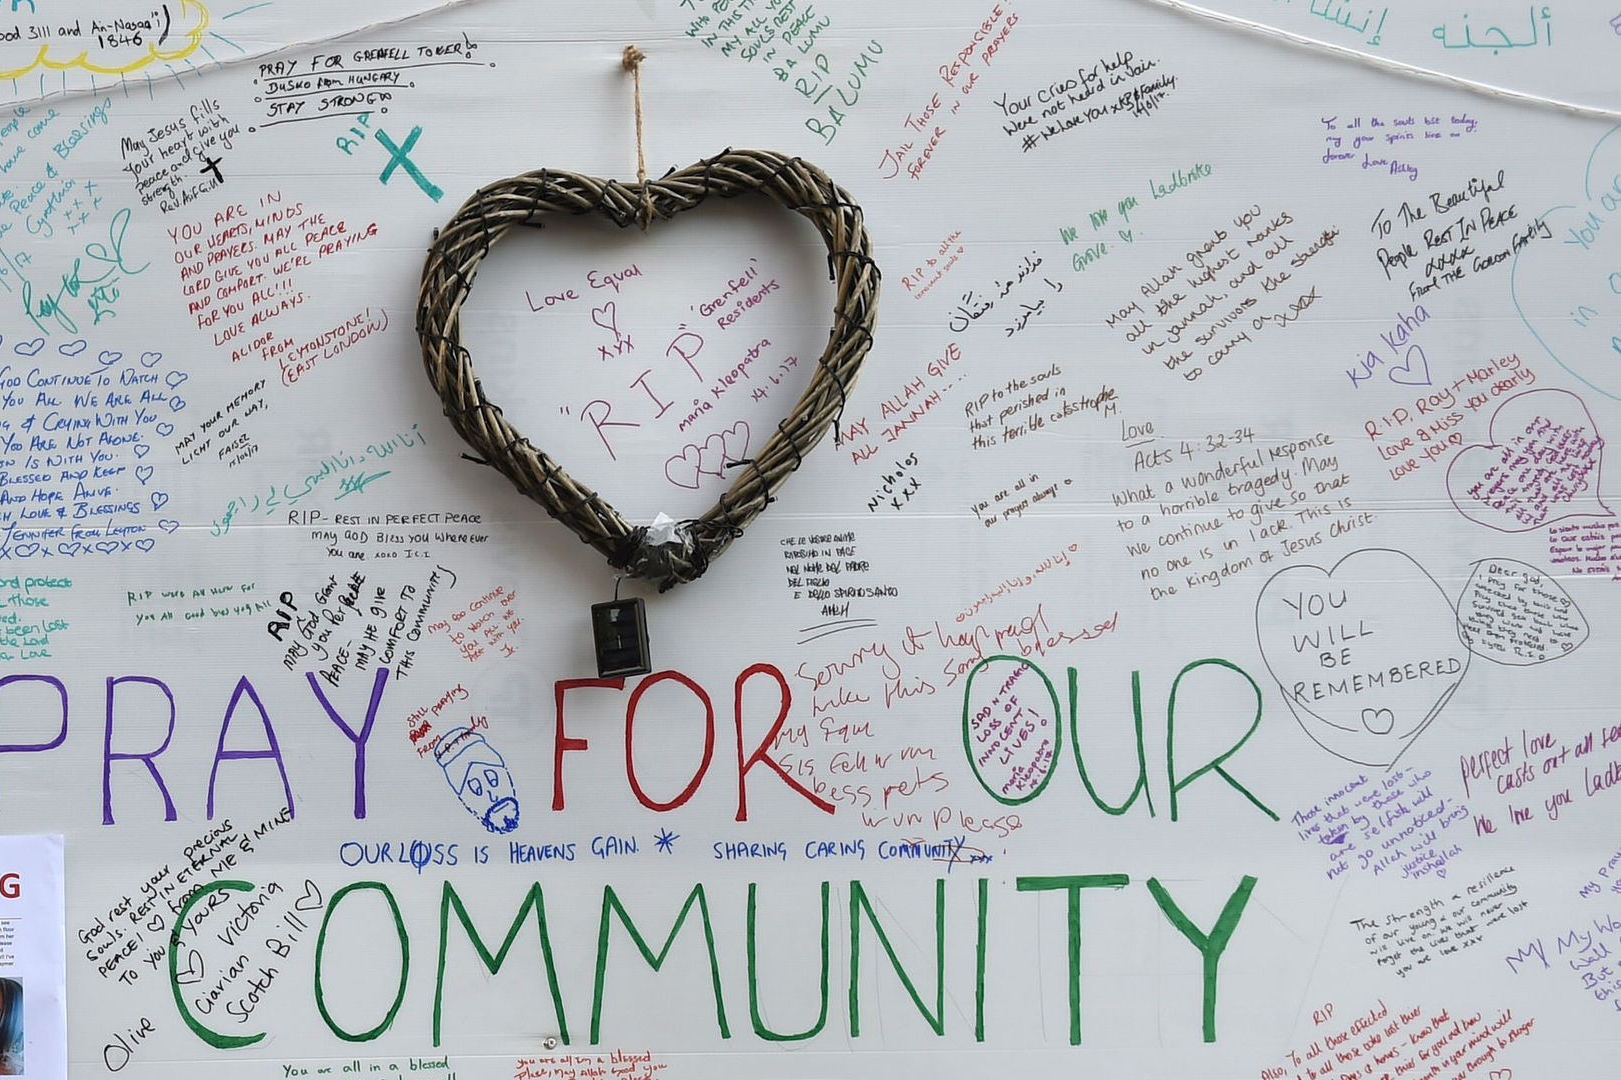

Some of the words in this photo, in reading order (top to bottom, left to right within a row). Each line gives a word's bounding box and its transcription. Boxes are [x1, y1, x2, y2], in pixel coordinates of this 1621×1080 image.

[58, 20, 83, 38] and
[97, 35, 143, 49] 1846
[259, 59, 298, 77] PRAY
[312, 54, 344, 72] FOR
[267, 101, 306, 117] STAY
[337, 112, 371, 156] RIP
[526, 288, 579, 312] Love
[1282, 589, 1347, 620] YOU
[1292, 620, 1374, 653] WILL
[1320, 648, 1352, 669] BE
[1293, 657, 1462, 704] REMEMBERED
[552, 663, 836, 823] FOR
[963, 655, 1280, 823] OUR
[340, 841, 393, 867] OUR
[474, 845, 489, 864] IS
[509, 841, 576, 864] HEAVENS
[713, 840, 788, 861] SHARING
[805, 839, 865, 860] CARING
[877, 835, 967, 875] COMMUNITY
[168, 873, 1258, 1050] COMMUNITY
